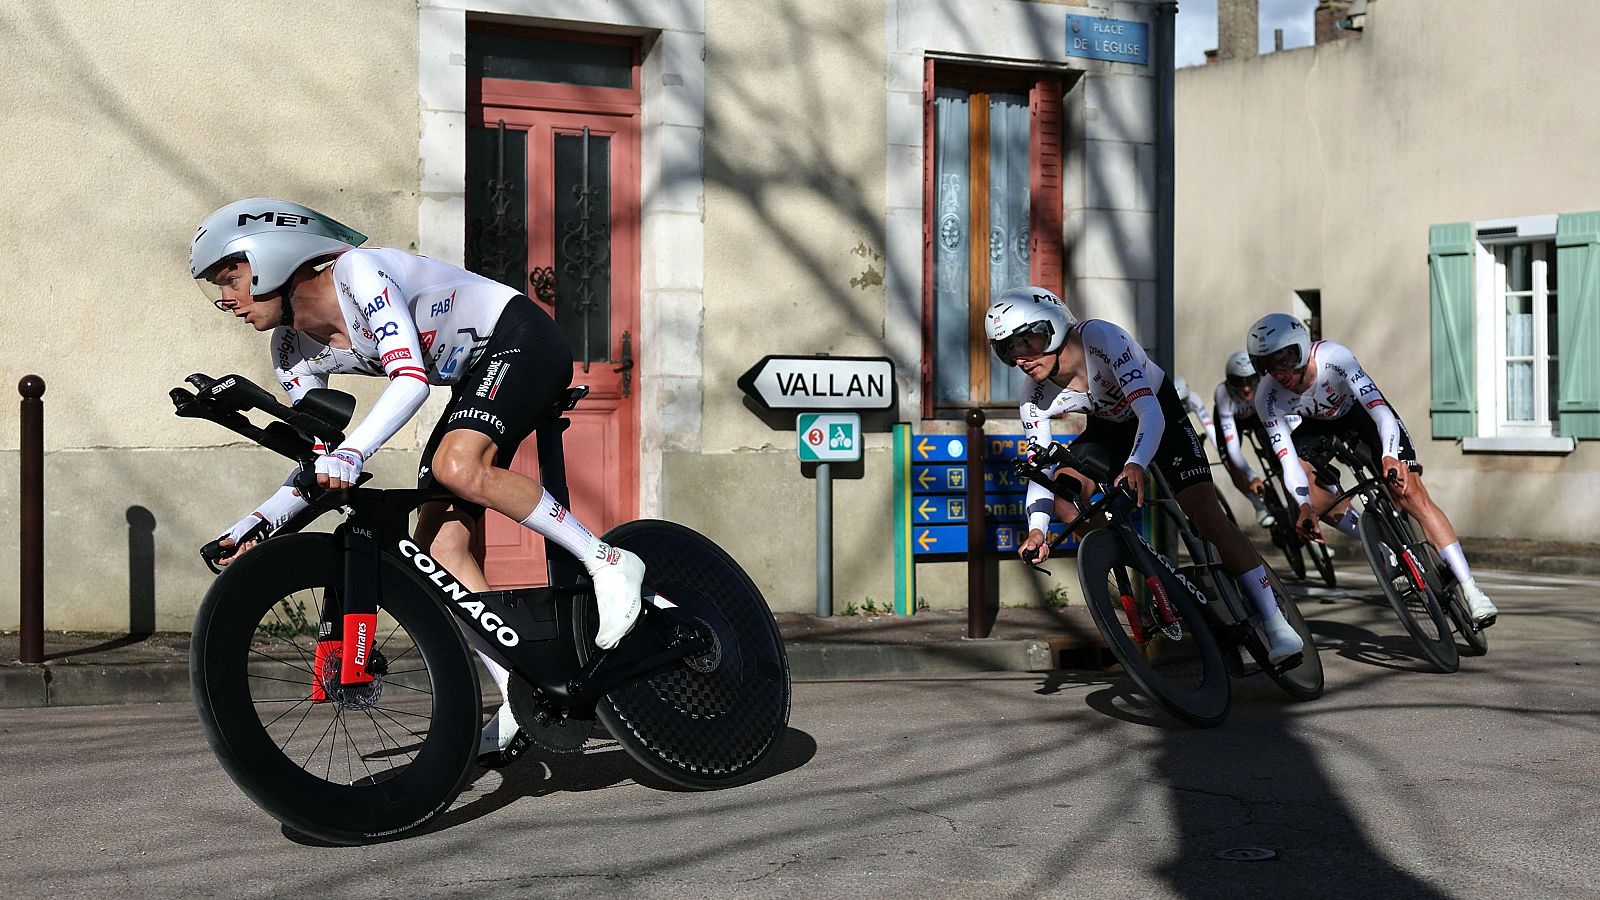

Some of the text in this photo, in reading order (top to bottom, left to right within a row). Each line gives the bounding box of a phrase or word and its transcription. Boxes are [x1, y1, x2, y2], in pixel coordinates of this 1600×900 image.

[1093, 22, 1124, 35] PLACE
[1073, 37, 1088, 50] DE
[237, 211, 316, 227] MET
[776, 372, 884, 397] VALLAN
[448, 407, 506, 435] Emirates
[811, 430, 821, 443] 3
[353, 527, 372, 539] UAE
[398, 539, 520, 648] COLNAGO
[354, 622, 367, 666] Emirates
